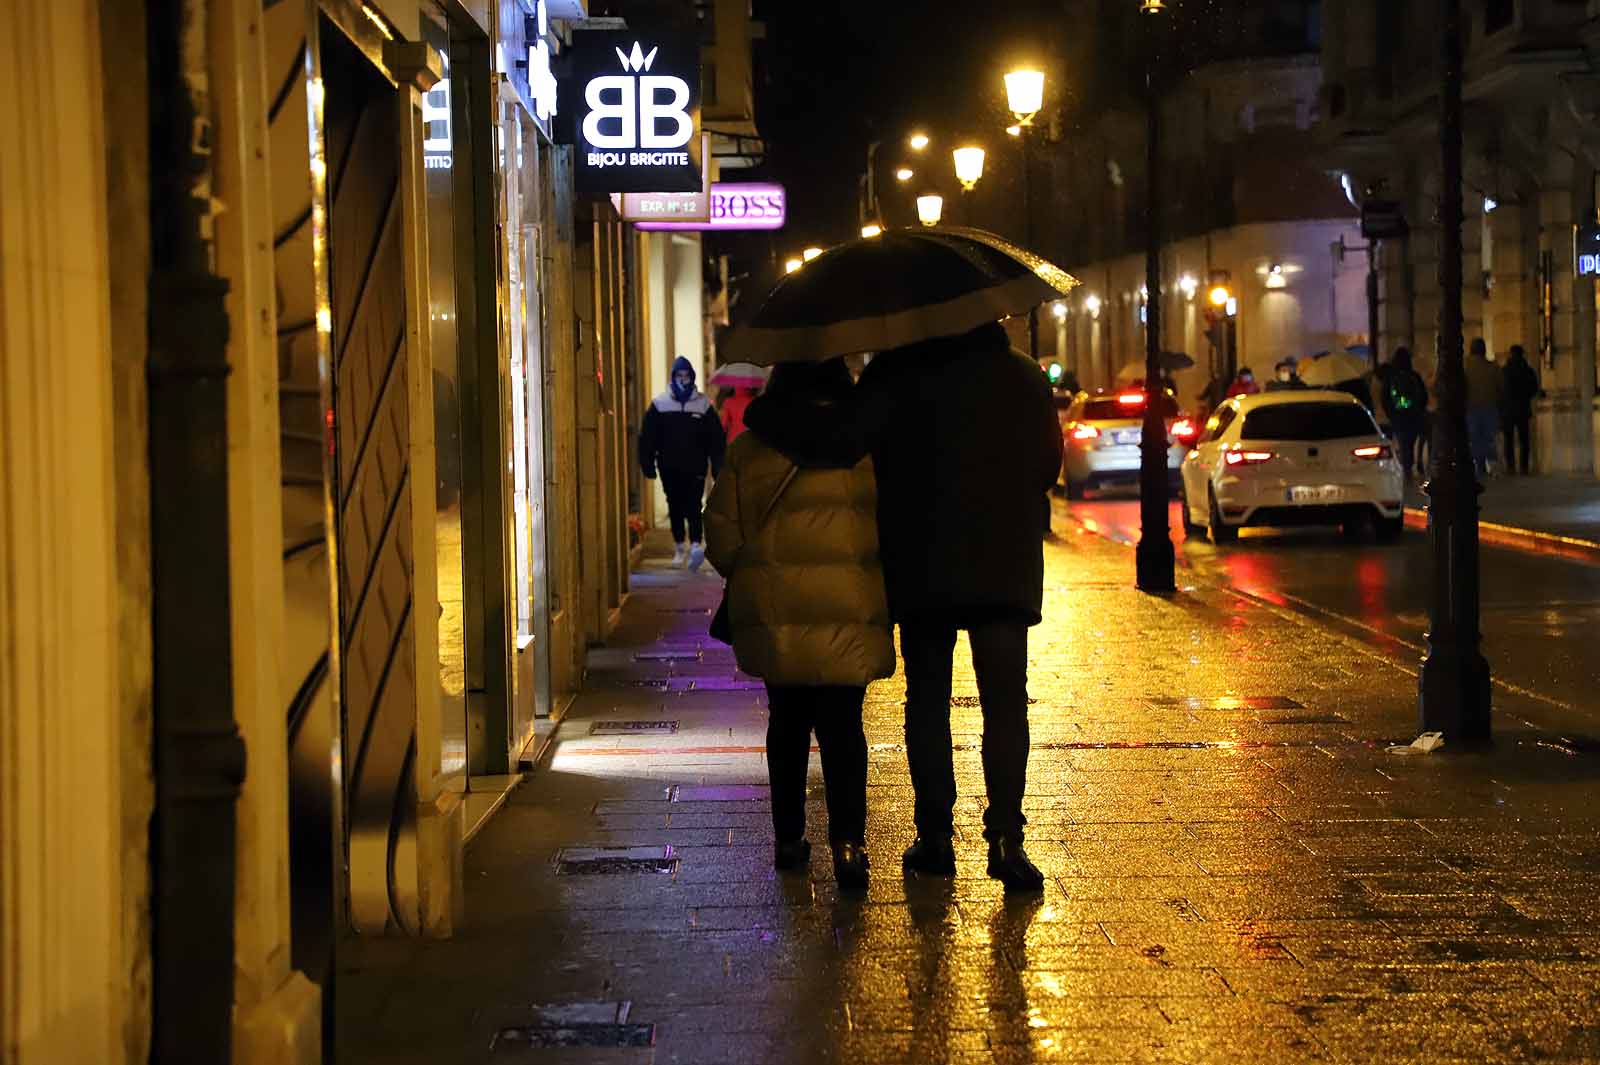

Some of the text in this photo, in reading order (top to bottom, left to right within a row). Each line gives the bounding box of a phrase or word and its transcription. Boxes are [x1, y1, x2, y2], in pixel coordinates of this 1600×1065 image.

[587, 152, 689, 169] BIJOU BRIGITTE
[683, 200, 697, 212] 12
[711, 194, 783, 219] BOSS
